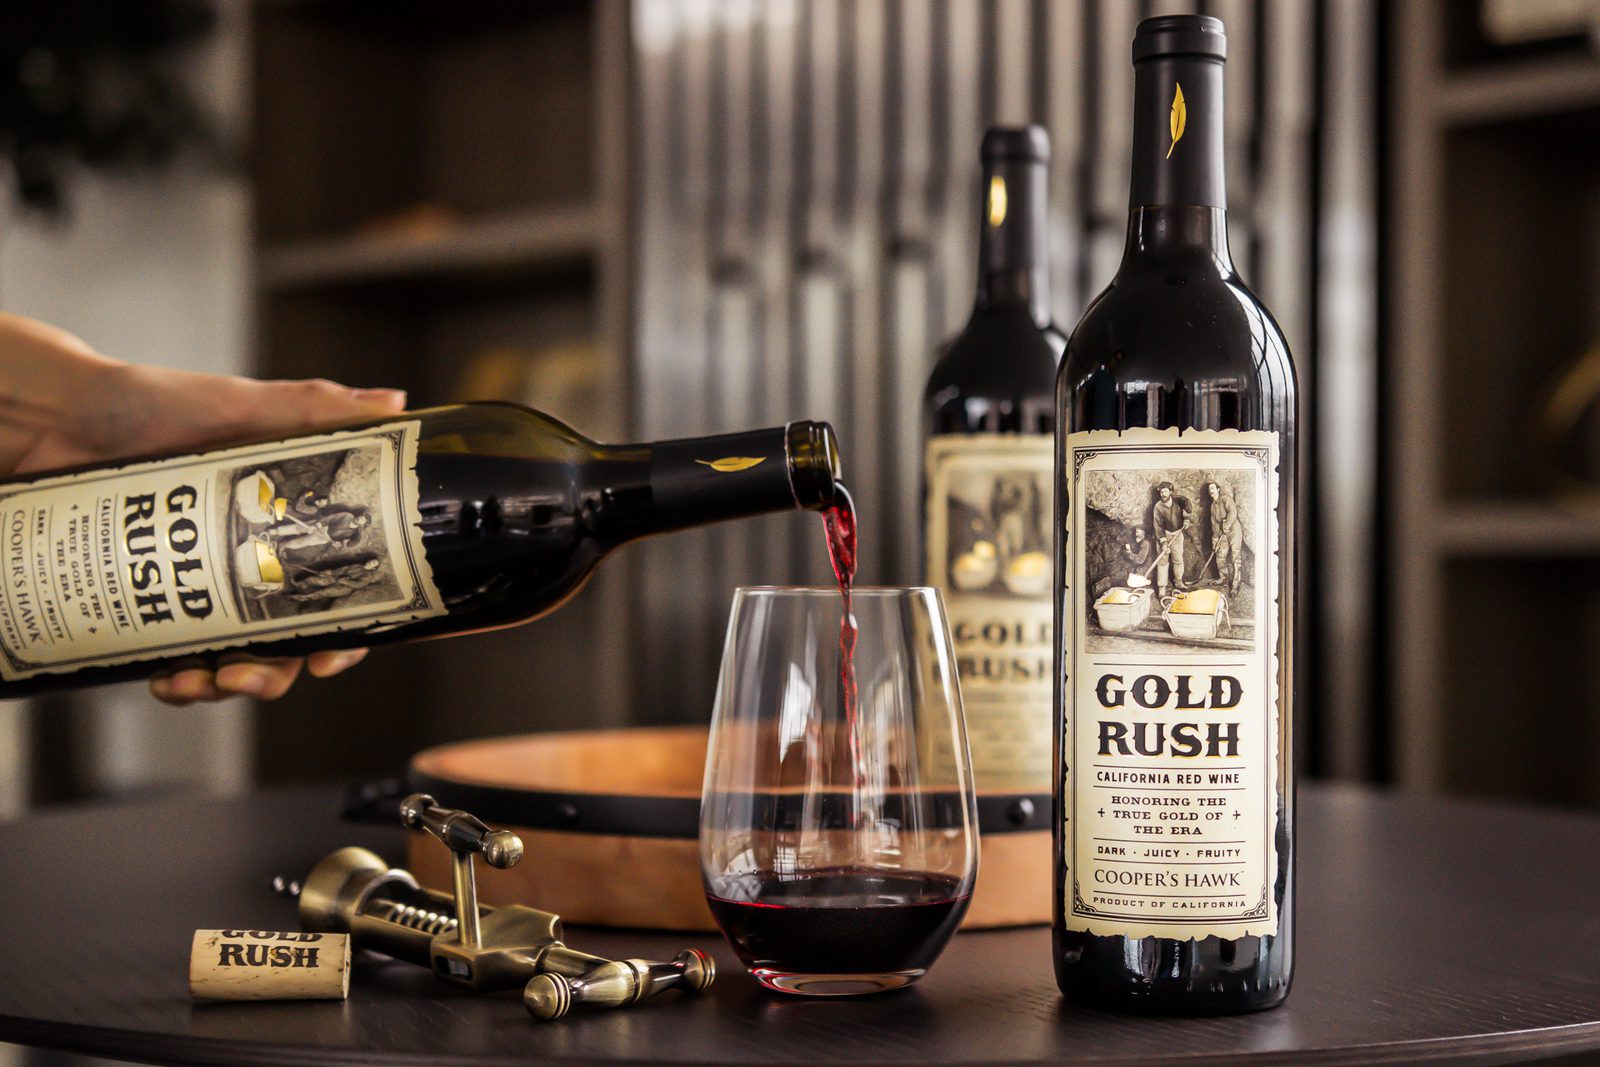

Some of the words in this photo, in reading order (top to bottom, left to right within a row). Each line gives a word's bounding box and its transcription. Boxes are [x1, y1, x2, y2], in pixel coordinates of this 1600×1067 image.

[37, 509, 46, 535] DARK
[68, 518, 77, 554] TRUE
[100, 498, 112, 566] CALIFORNIA
[11, 508, 27, 589] COOPER'S
[56, 540, 66, 566] THE
[123, 491, 174, 626] RUSH
[166, 484, 213, 619] GOLD
[36, 553, 48, 585] JUICY
[71, 561, 84, 597] GOLD
[81, 515, 95, 588] HONORING
[90, 593, 104, 620] THE
[60, 574, 72, 603] ERA
[105, 571, 118, 595] RED
[17, 591, 42, 643] HAWK
[45, 599, 64, 639] FRUITY
[80, 603, 91, 619] OF
[113, 600, 130, 628] WINE
[1095, 673, 1244, 710] GOLD
[1097, 720, 1241, 758] RUSH
[1096, 771, 1170, 784] CALIFORNIA
[1176, 774, 1202, 784] RED
[1208, 773, 1240, 784] WINE
[1111, 795, 1191, 806] HONORING
[1197, 797, 1227, 806] THE
[1112, 809, 1151, 820] TRUE
[1159, 811, 1199, 821] GOLD
[1205, 812, 1223, 820] OF
[1133, 825, 1163, 835] THE
[1170, 826, 1203, 835] ERA
[1097, 845, 1126, 855] DARK
[1143, 849, 1180, 858] JUICY
[1197, 848, 1241, 858] FRUITY
[1094, 868, 1179, 887] COOPER'S
[1185, 872, 1241, 888] HAWK
[1092, 896, 1145, 908] PRODUCT
[1151, 900, 1166, 908] OF
[1172, 900, 1246, 909] CALIFORNIA
[218, 943, 320, 967] RUSH
